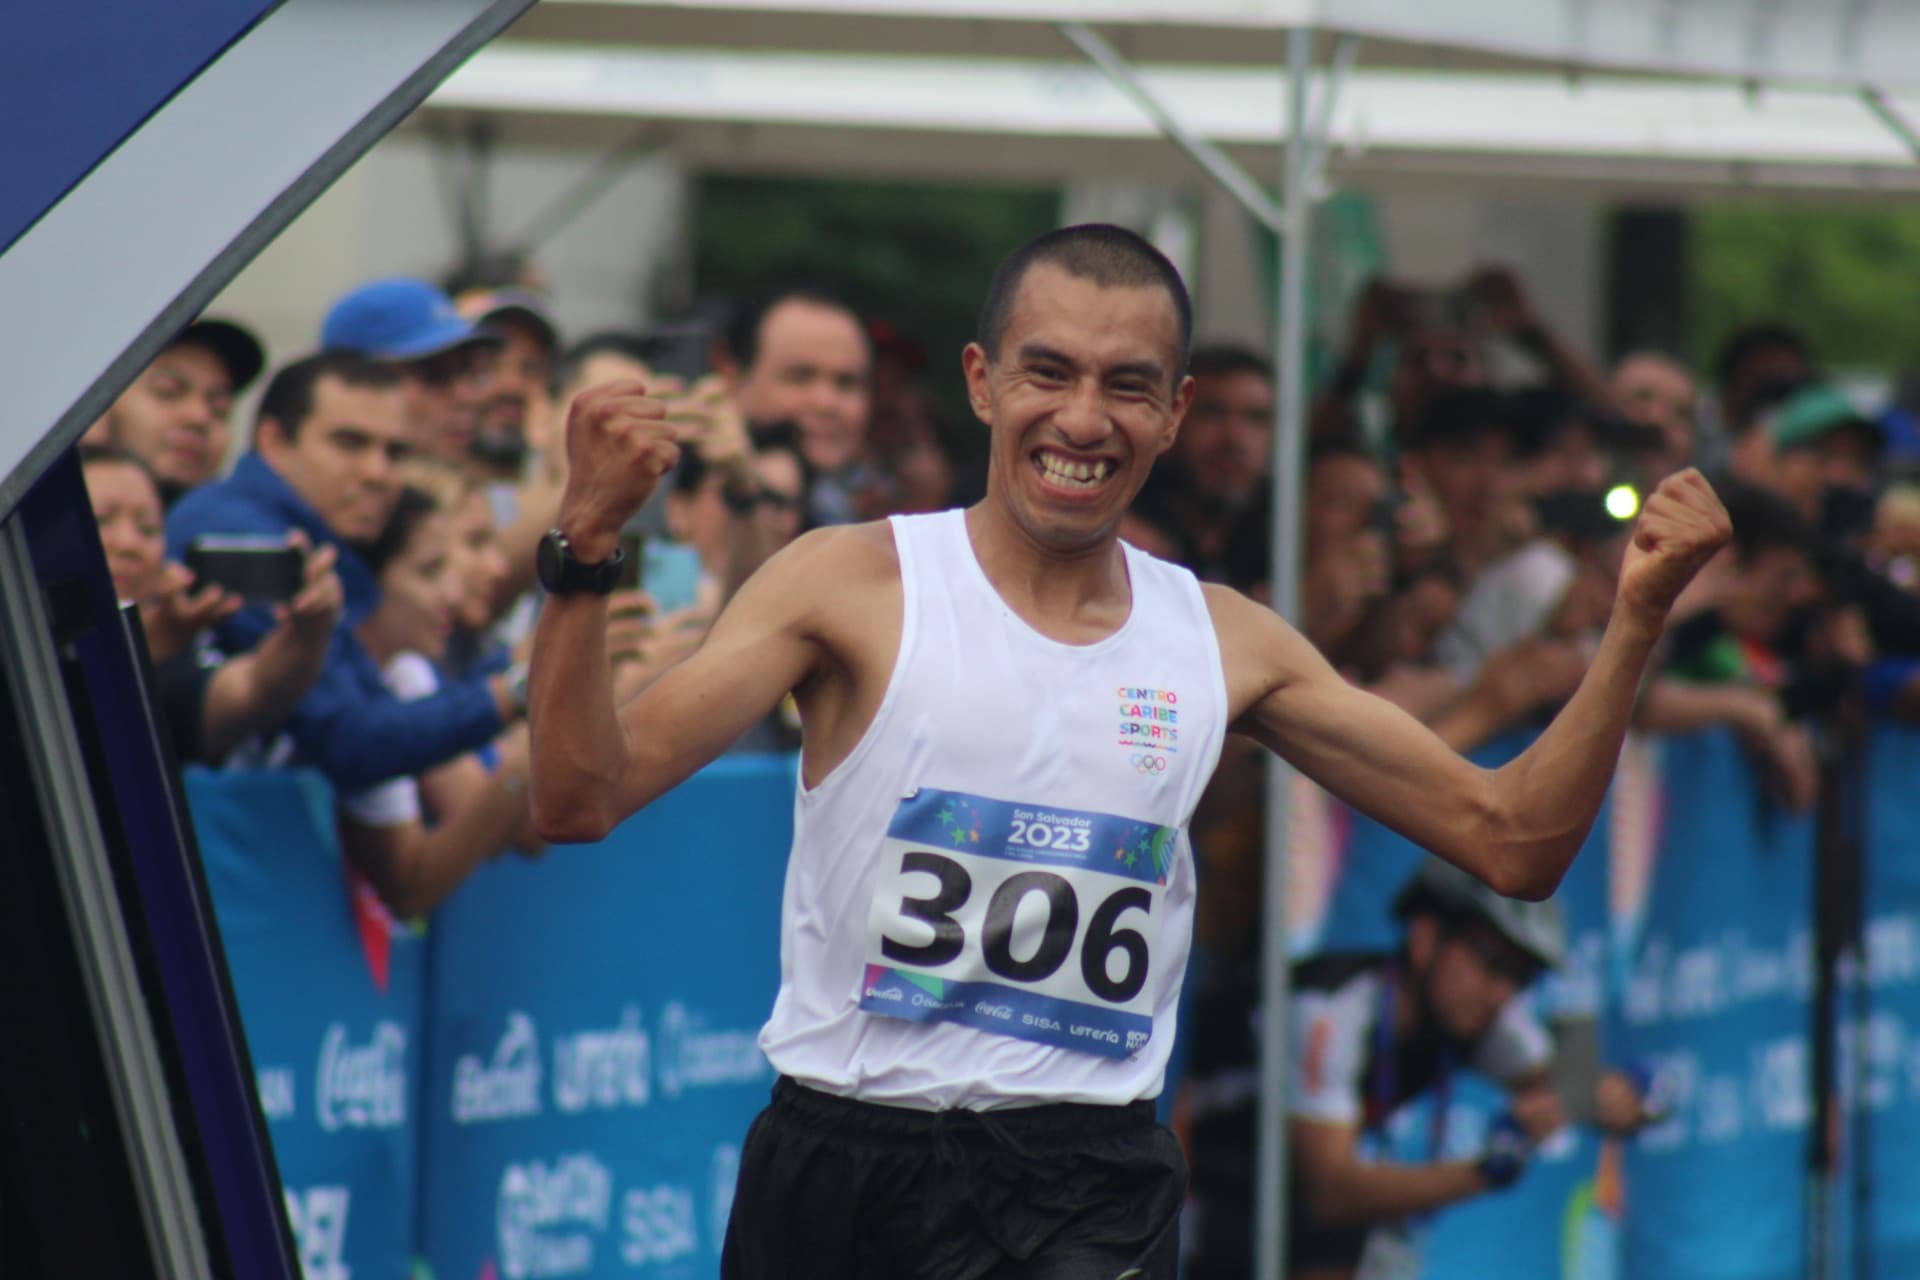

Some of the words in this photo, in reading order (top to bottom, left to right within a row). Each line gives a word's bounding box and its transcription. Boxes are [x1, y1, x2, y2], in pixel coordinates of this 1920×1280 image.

[1117, 688, 1177, 704] CENTRO
[1119, 704, 1177, 723] CARIBE
[1119, 723, 1178, 740] SPORTS
[1013, 808, 1034, 821] San
[1036, 812, 1091, 828] Salvador
[1007, 820, 1091, 852] 2023
[881, 852, 1153, 1004] 306
[1022, 1013, 1060, 1031] SISA
